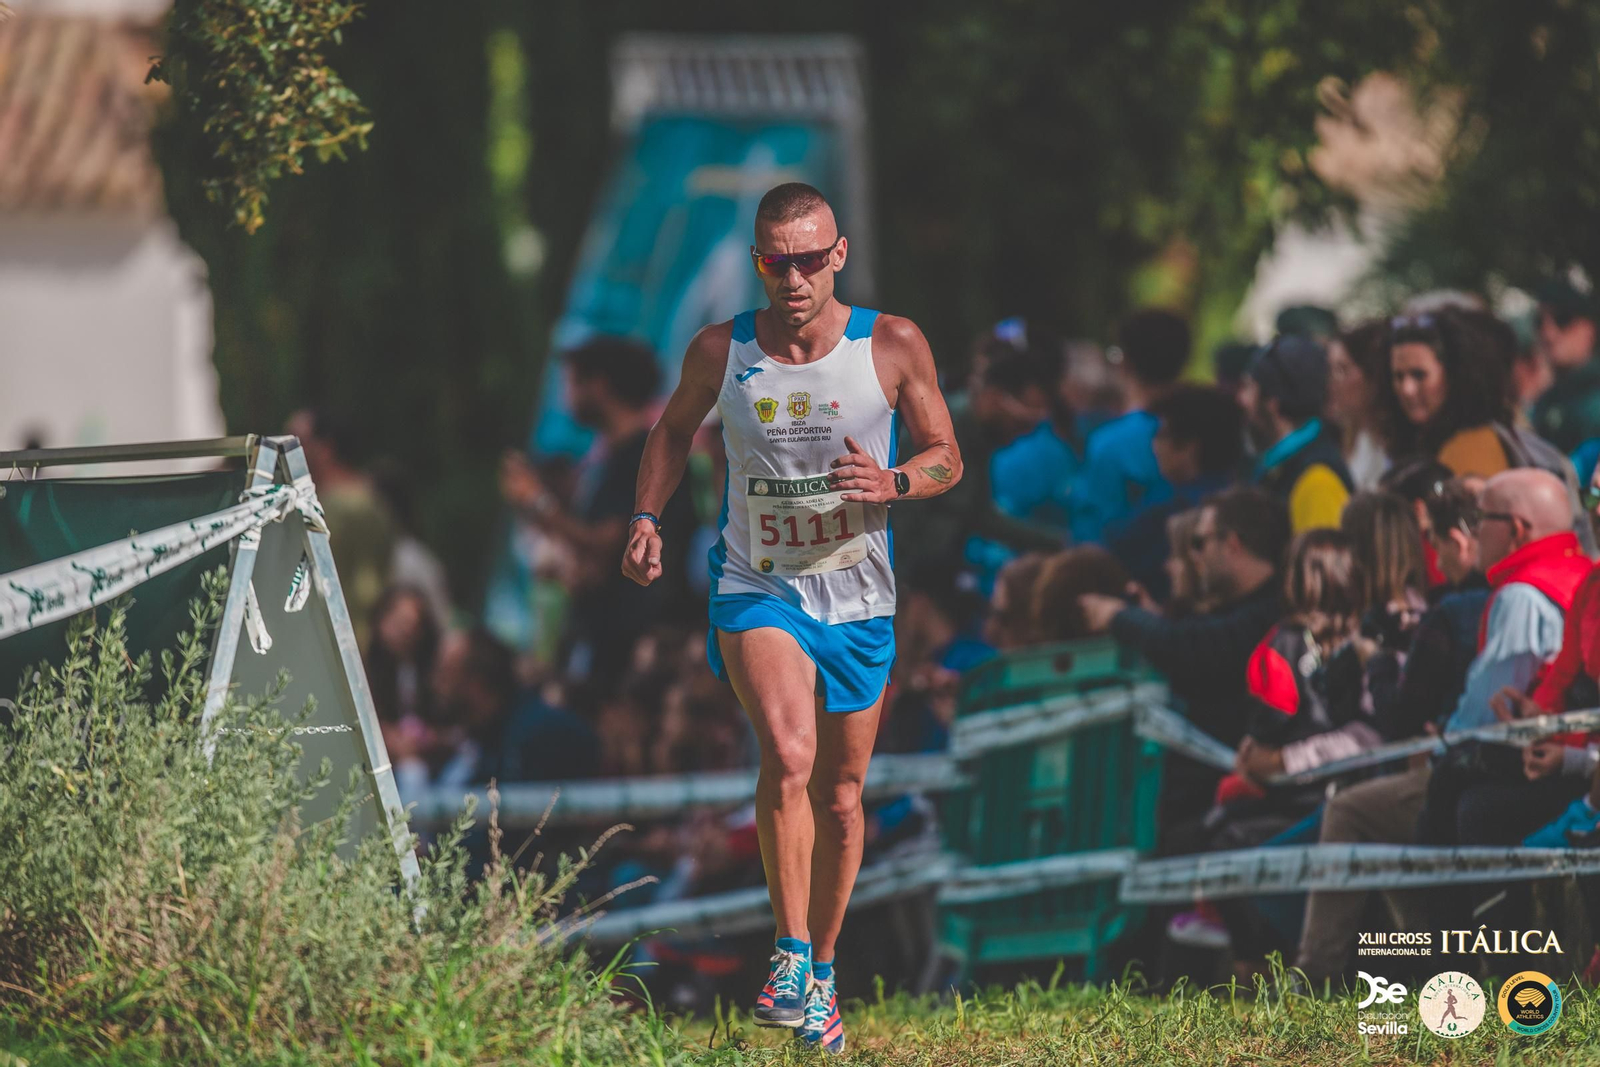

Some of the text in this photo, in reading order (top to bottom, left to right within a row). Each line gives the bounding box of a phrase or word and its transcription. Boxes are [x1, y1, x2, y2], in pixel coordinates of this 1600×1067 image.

[767, 427, 832, 436] PEÑA DEPORTIVA
[775, 479, 828, 494] ITÁLICA
[760, 508, 855, 547] 5111
